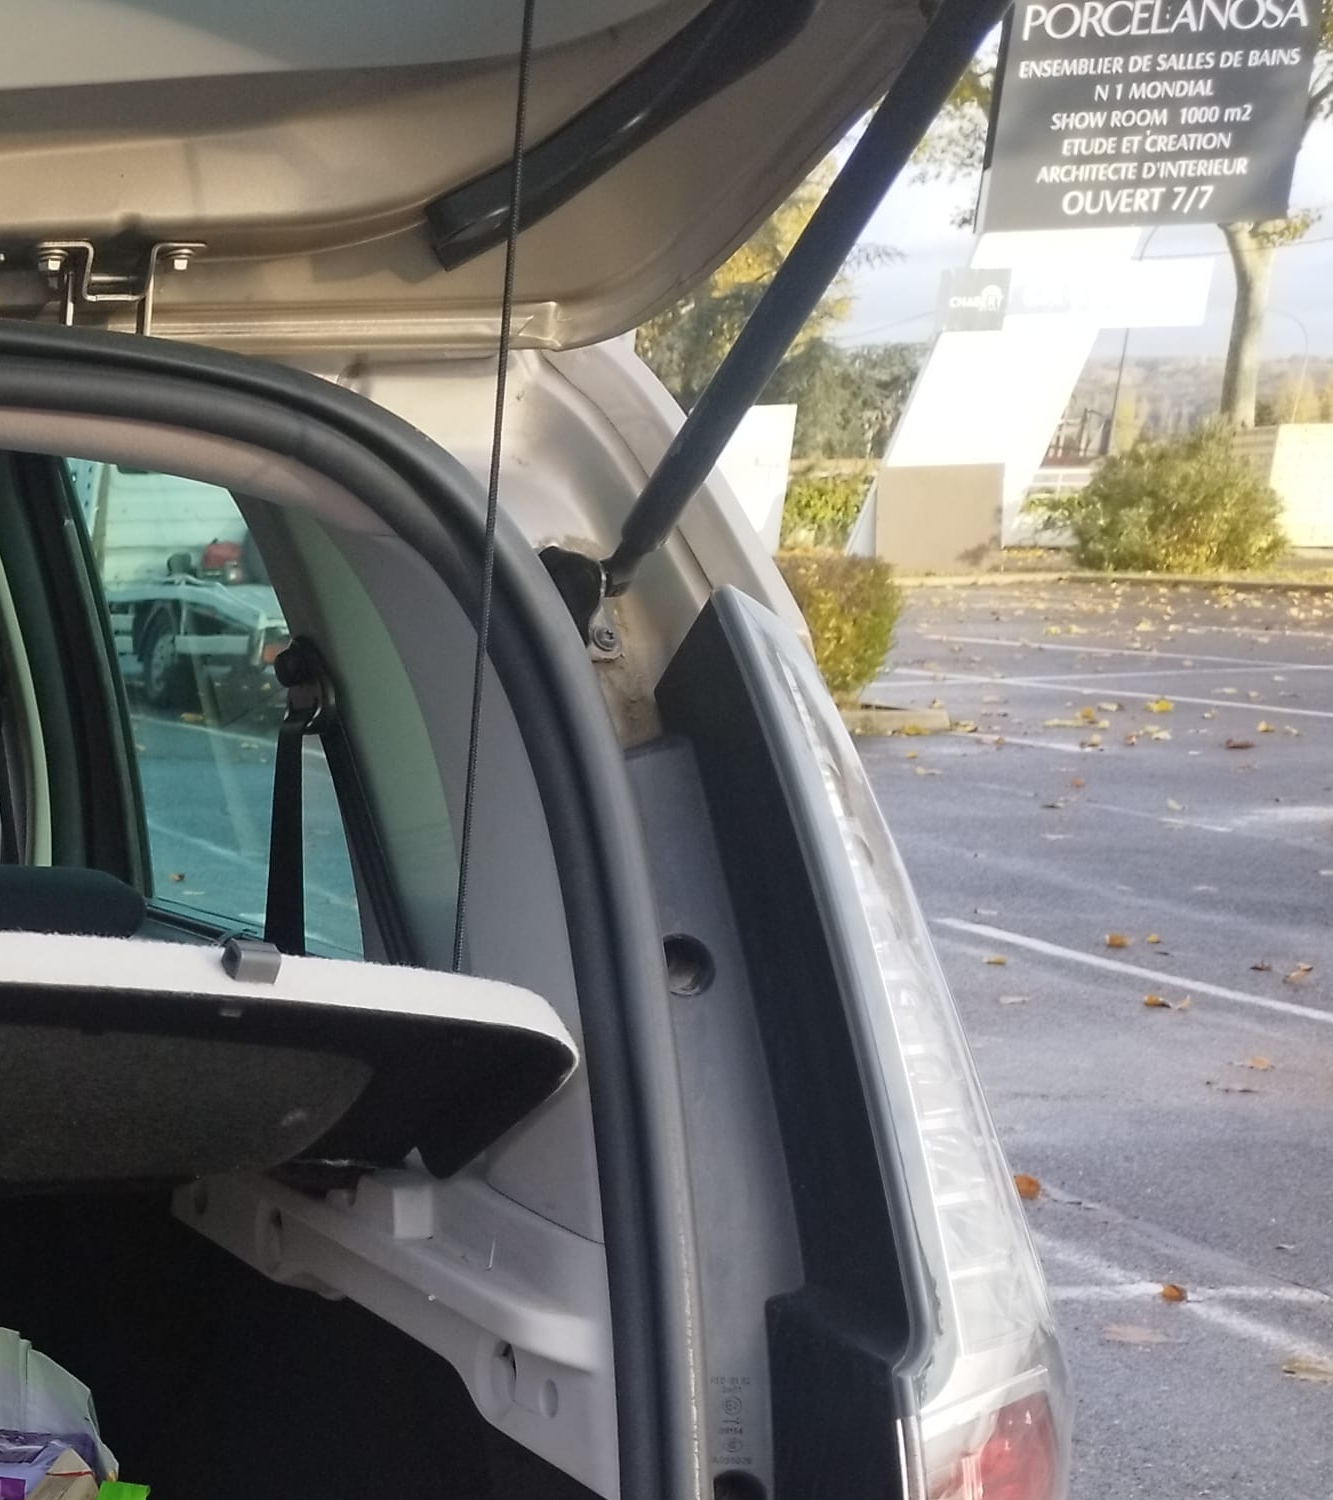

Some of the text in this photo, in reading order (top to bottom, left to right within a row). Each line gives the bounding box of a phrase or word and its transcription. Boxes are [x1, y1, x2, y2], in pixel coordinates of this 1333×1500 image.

[1022, 0, 1309, 41] PORCELANOSA
[1019, 47, 1301, 79] ENSEMBLIER DE SALLES DE BAINS
[1094, 79, 1214, 102] N 1 MONDIAL
[1050, 104, 1253, 131] SHOW ROOM 1000 m2
[1062, 132, 1232, 156] ETUDE ET CREATION
[1036, 157, 1249, 184] ARCHITECTE D'INTERIEUR
[1062, 184, 1215, 215] OUVERT 7/7
